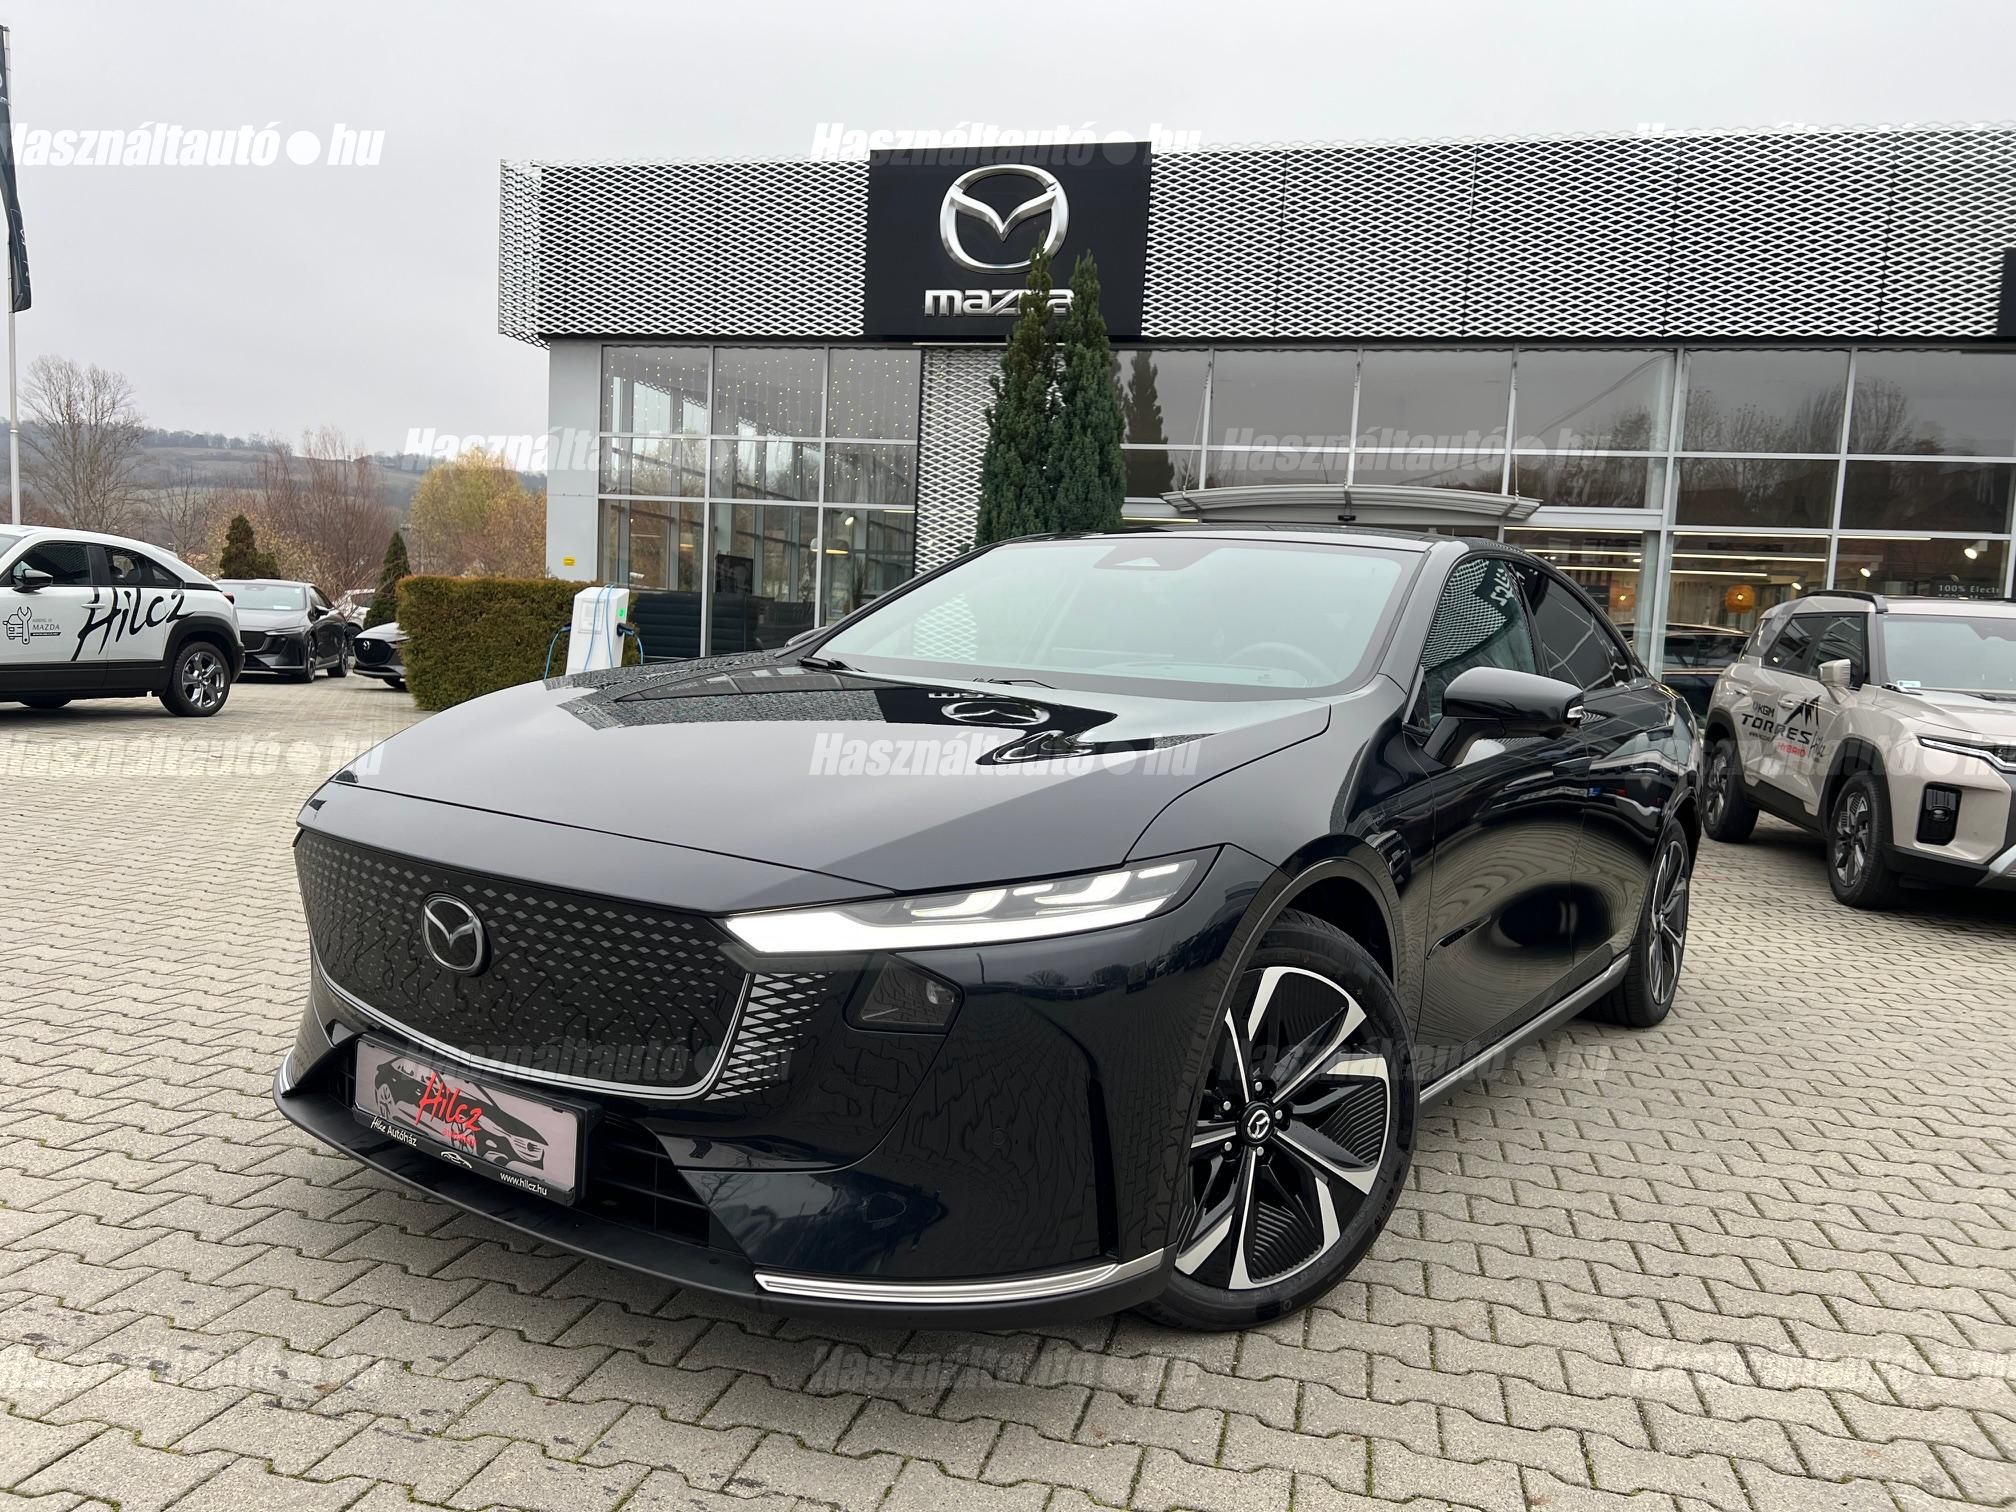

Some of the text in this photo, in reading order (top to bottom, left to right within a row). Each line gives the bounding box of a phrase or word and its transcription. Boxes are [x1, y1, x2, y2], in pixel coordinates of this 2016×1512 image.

[33, 623, 60, 631] MAZDA
[1757, 703, 1776, 718] KGM
[1742, 713, 1813, 745] TORRES
[387, 1125, 418, 1147] Autóház
[499, 1172, 548, 1196] www.hilcz.hu
